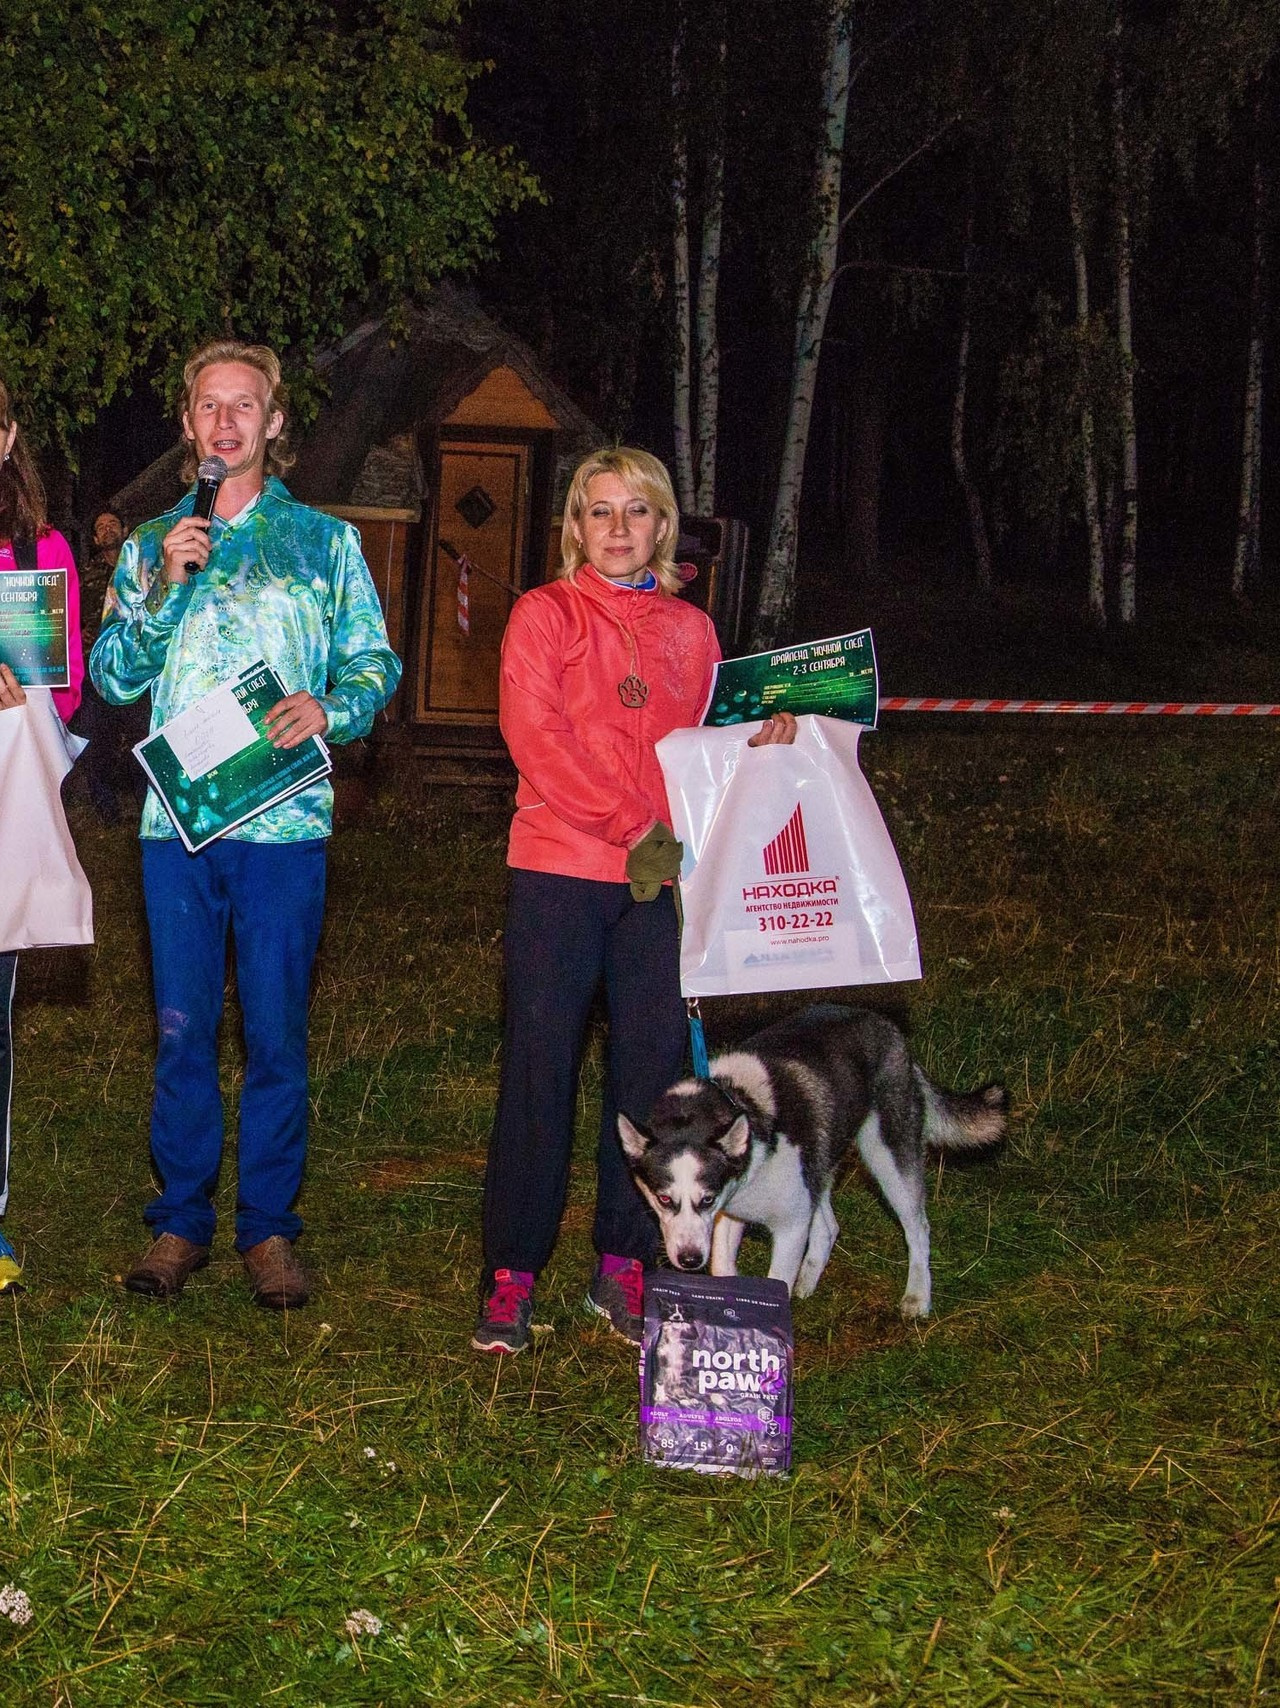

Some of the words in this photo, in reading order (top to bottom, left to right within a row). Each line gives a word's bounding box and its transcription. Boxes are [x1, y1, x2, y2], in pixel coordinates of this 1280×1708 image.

[1, 591, 38, 603] СЕНТЯБРЯ
[770, 649, 809, 667] ДРАЙЛЕНД
[792, 664, 807, 676] 2-3
[809, 656, 846, 673] СЕНТЯБРЯ
[742, 880, 837, 900] НАХОДКА
[746, 903, 782, 912] АГЕНТСТВО
[783, 898, 839, 910] НЕДВИЖИМОСТИ
[758, 911, 833, 932] 310-22-22
[771, 935, 829, 946] www.nahodka.pro
[692, 1348, 780, 1373] north
[698, 1370, 761, 1394] paw
